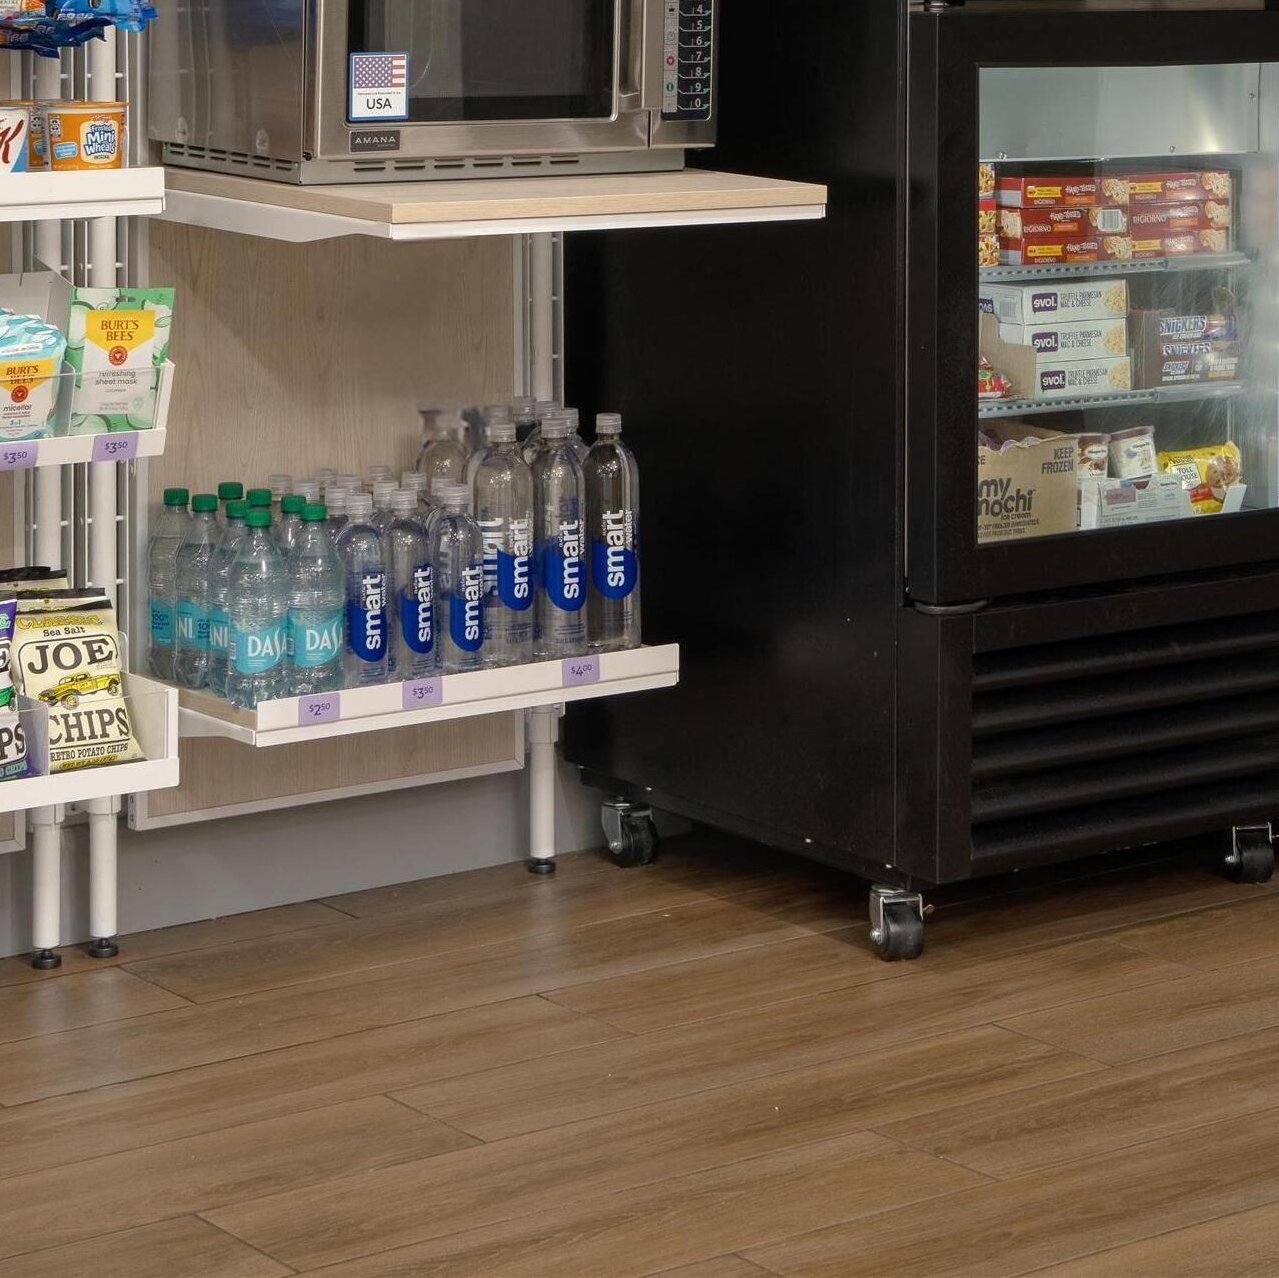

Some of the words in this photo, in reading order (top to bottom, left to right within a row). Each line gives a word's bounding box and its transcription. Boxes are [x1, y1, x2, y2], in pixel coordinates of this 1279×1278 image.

[366, 98, 392, 109] USA
[86, 131, 115, 145] Mini
[355, 136, 396, 144] AMANA
[84, 143, 116, 156] Wheats
[1060, 291, 1078, 301] TRUFFLE
[1079, 290, 1102, 299] PARMESAN
[101, 319, 139, 331] BURT'S
[106, 331, 134, 341] BEES
[96, 378, 118, 386] sheet
[120, 377, 138, 385] mask
[1053, 447, 1074, 460] KEEP
[1041, 460, 1074, 474] FROZEN
[1177, 466, 1194, 475] TOLL
[979, 477, 1012, 498] my
[1001, 512, 1013, 520] ice
[1014, 511, 1032, 520] cream
[561, 520, 579, 600] smart
[365, 574, 382, 650] smart
[27, 638, 114, 674] JOE
[50, 707, 130, 744] CHIPS
